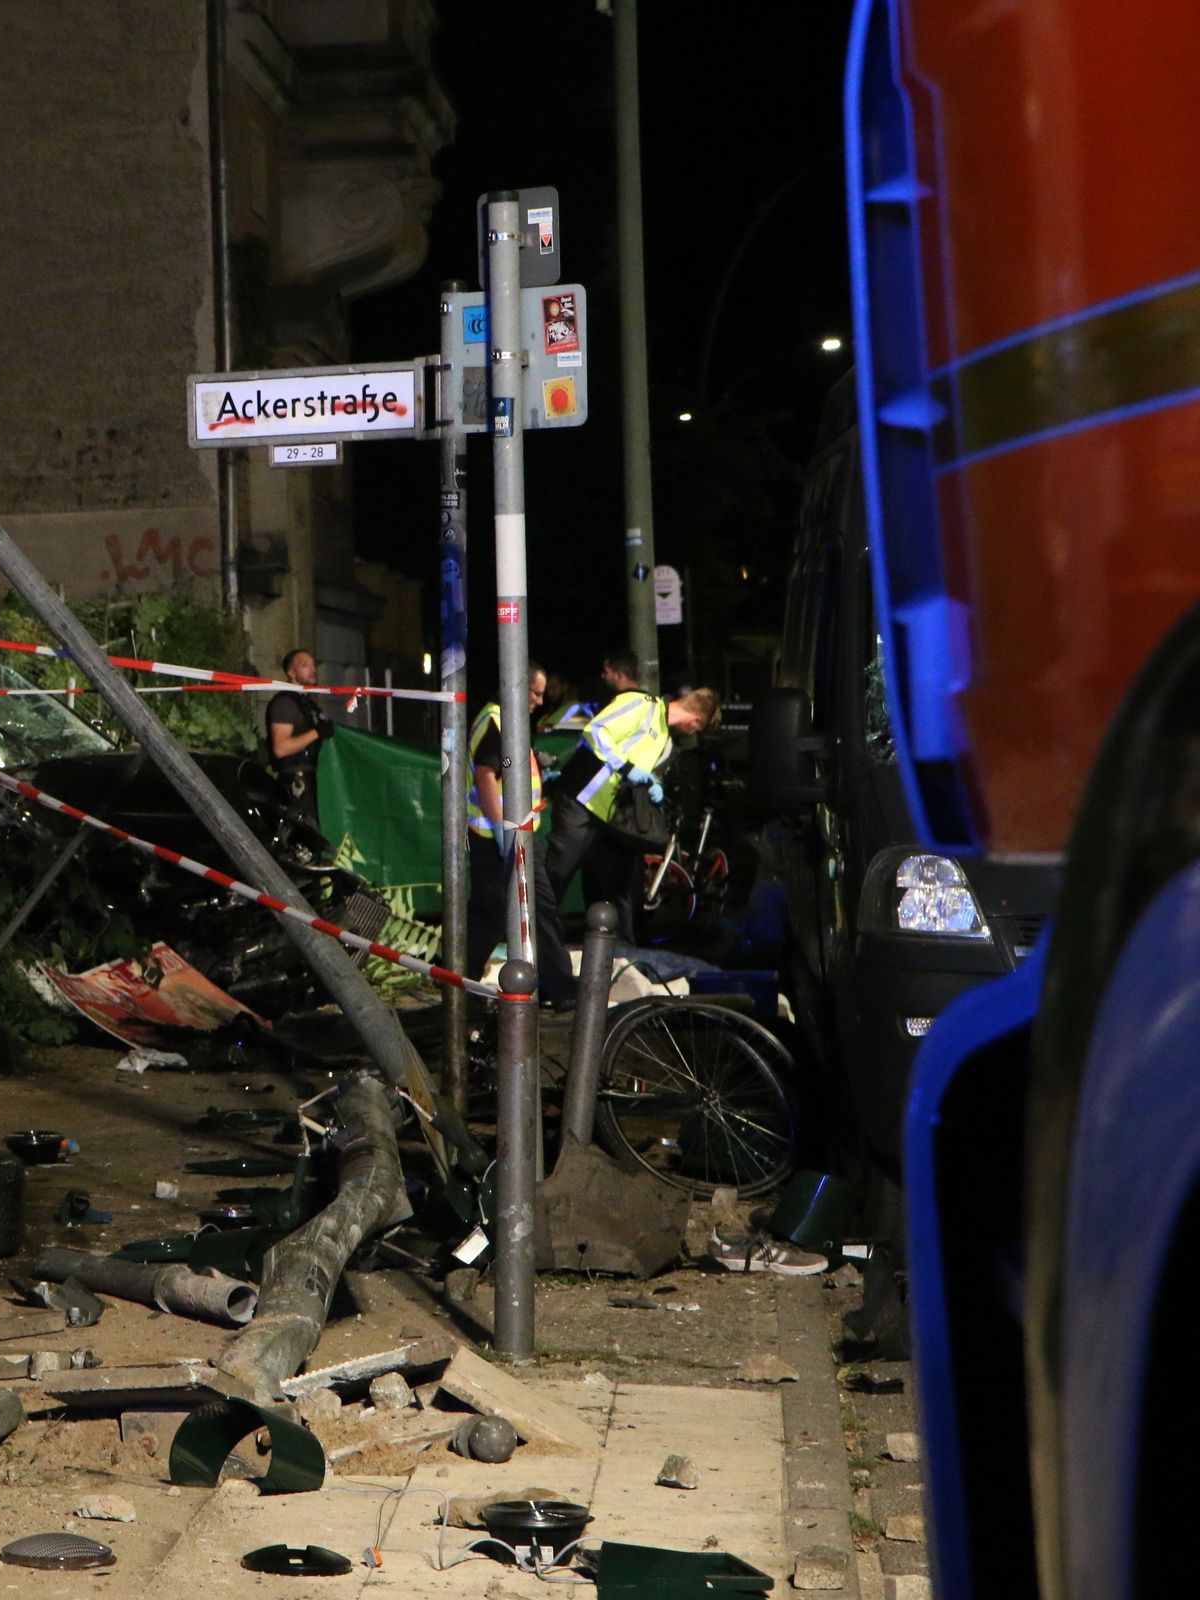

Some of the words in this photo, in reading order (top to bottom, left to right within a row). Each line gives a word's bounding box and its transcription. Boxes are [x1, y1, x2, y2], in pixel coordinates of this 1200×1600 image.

[217, 384, 397, 422] Ackerstraße
[286, 447, 299, 460] 29
[310, 446, 324, 459] 28
